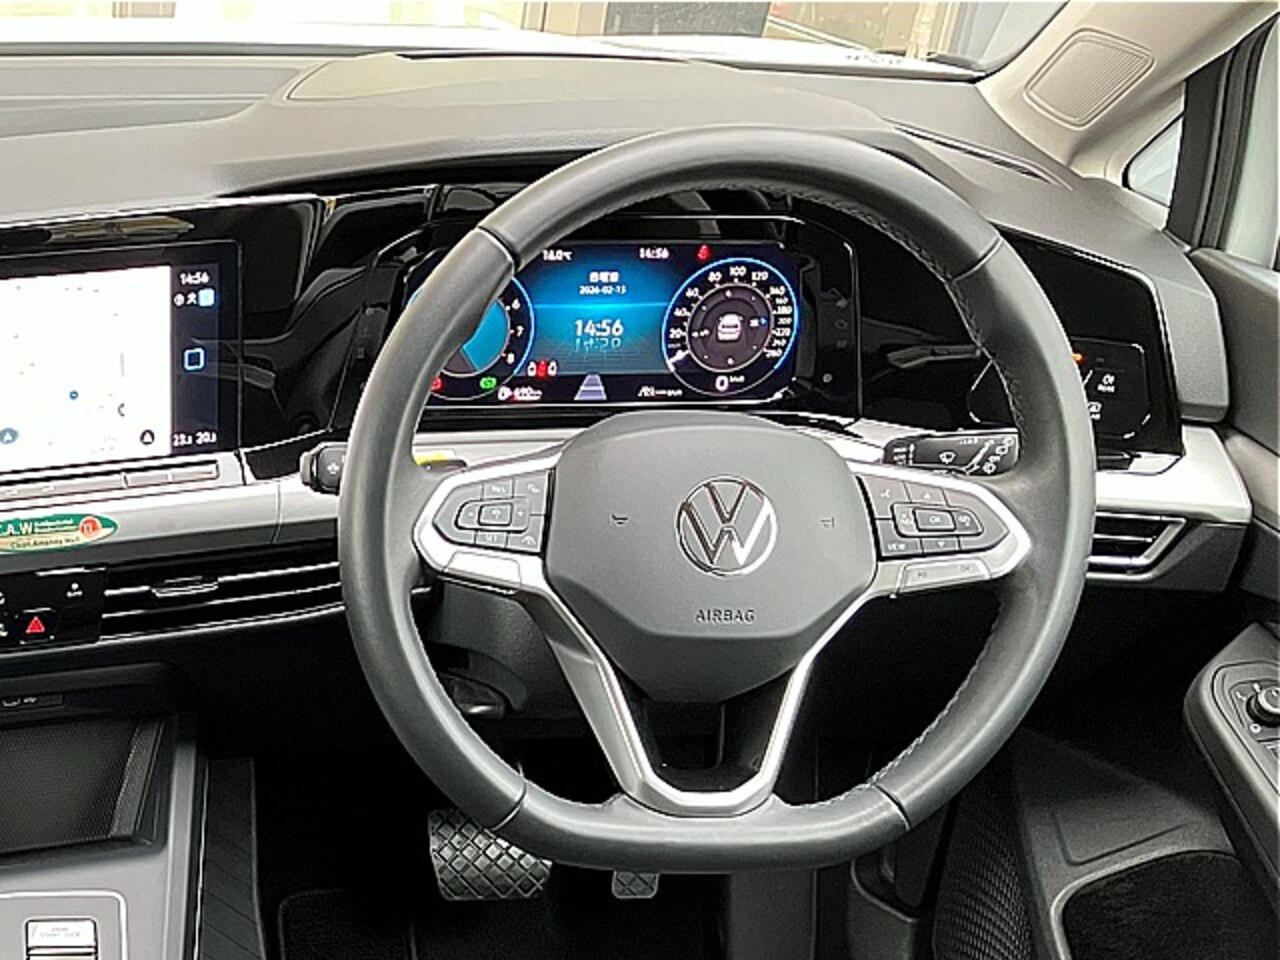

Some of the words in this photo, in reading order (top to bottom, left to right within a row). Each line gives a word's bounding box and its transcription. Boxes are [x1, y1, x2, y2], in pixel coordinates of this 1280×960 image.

[639, 247, 670, 259] 14:56
[707, 271, 723, 282] 80
[729, 265, 747, 277] 100
[751, 271, 769, 281] 120
[179, 271, 210, 285] 14:56
[685, 287, 700, 297] 60
[511, 298, 521, 310] 6
[673, 307, 688, 317] 40
[575, 320, 624, 337] 14:56
[669, 327, 682, 339] 20
[715, 375, 729, 391] 0
[677, 478, 776, 574] VW
[695, 608, 756, 623] AIRBAG
